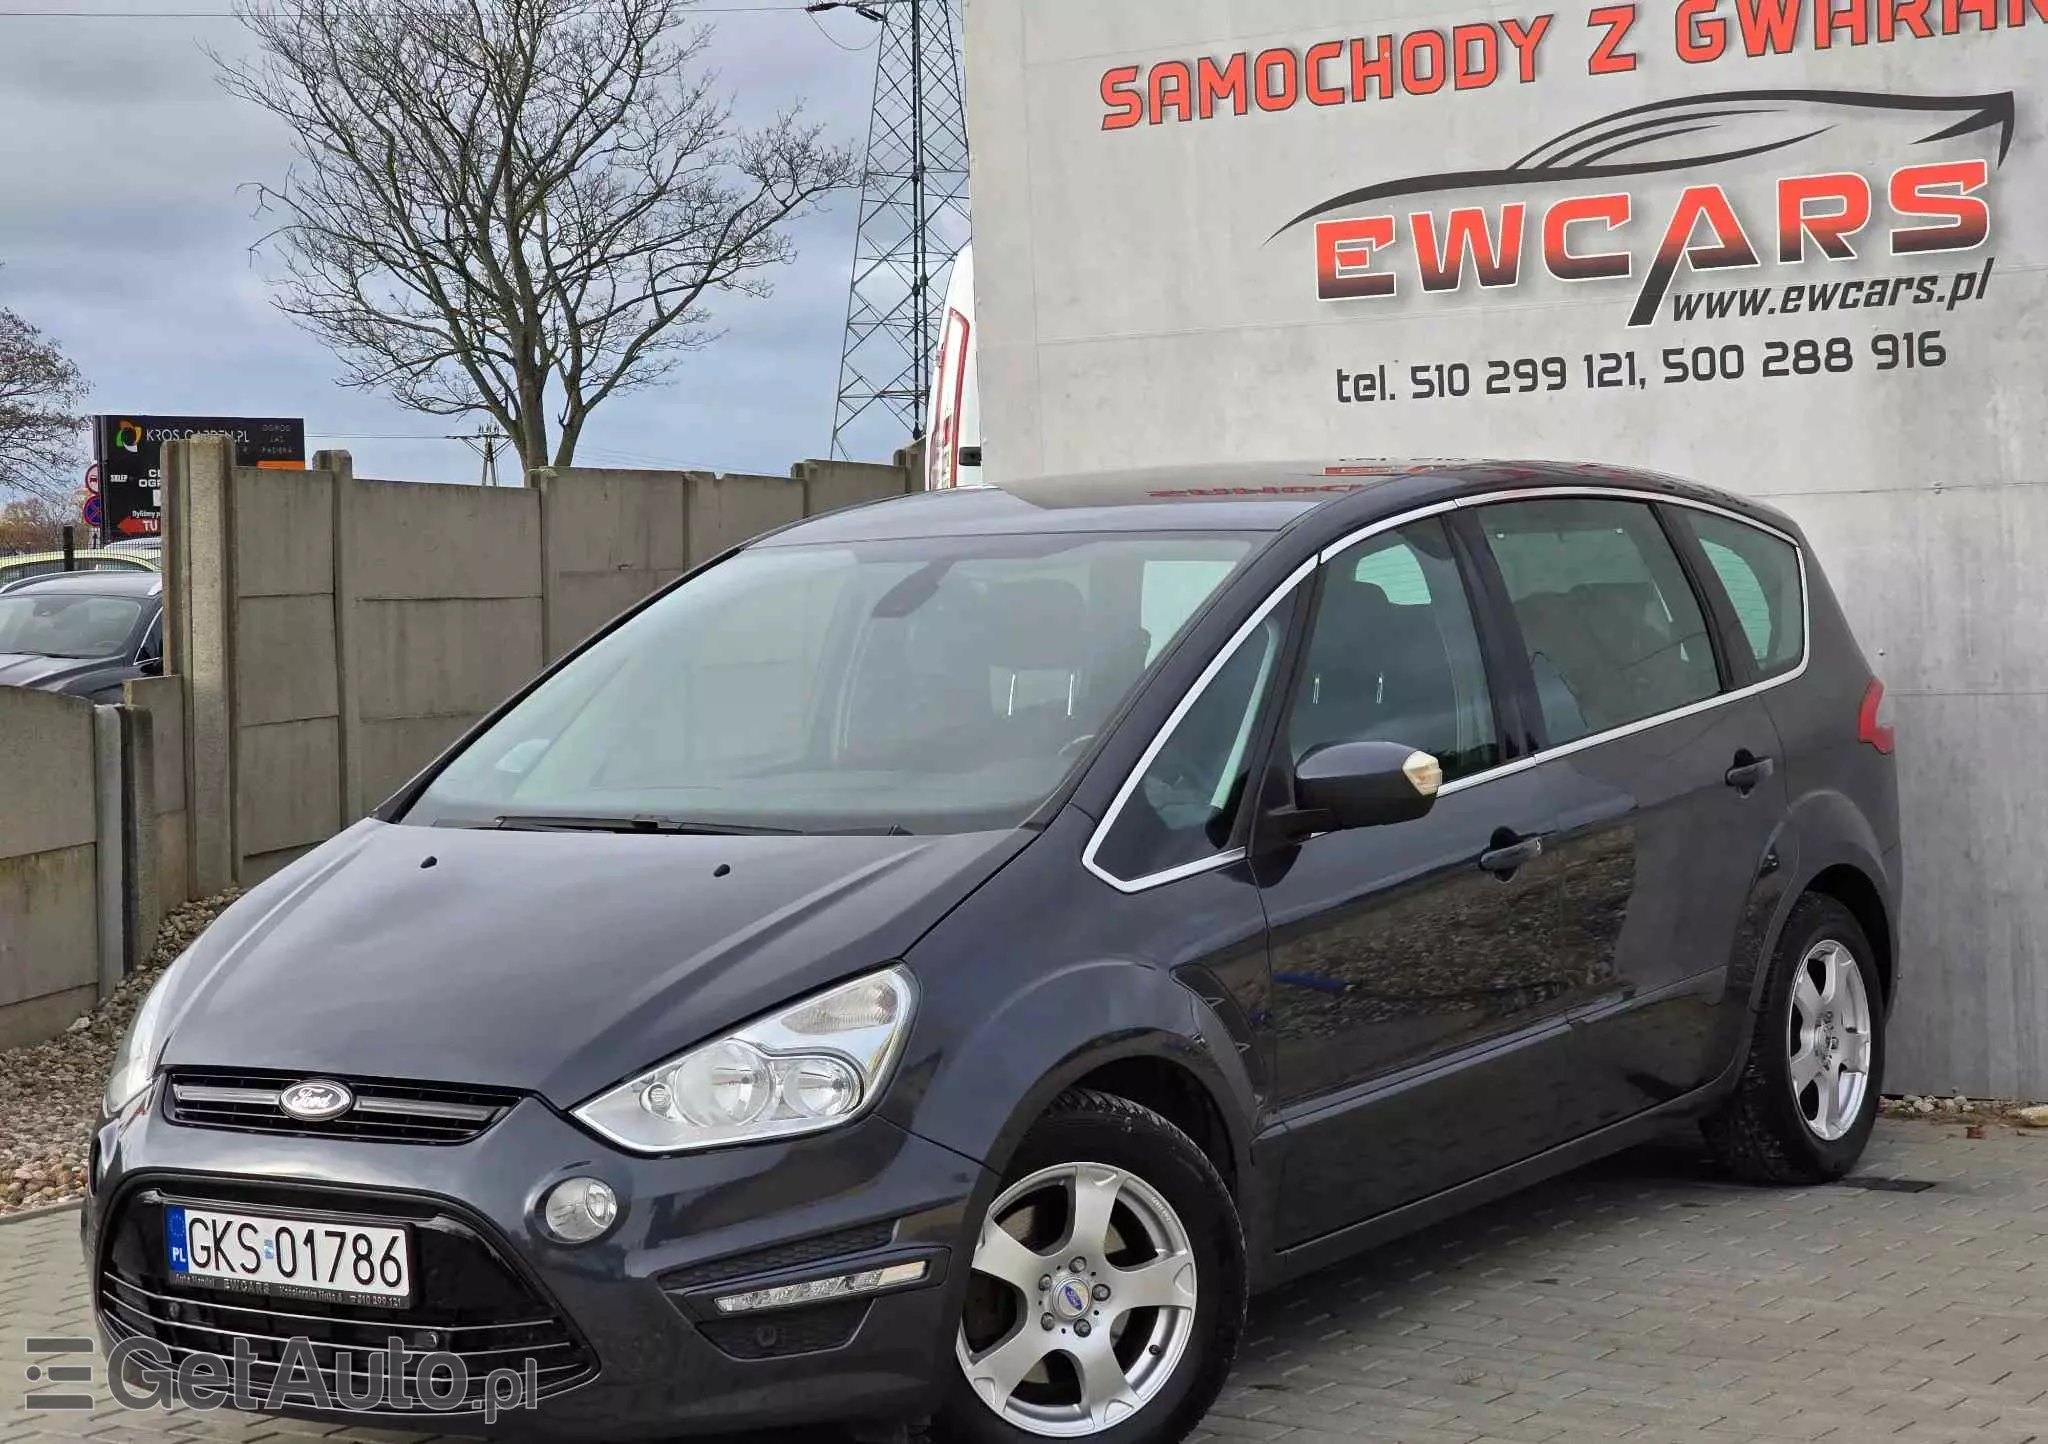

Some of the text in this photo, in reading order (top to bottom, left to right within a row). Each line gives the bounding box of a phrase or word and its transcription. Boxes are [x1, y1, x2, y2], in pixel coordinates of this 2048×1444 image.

[1100, 13, 1555, 131] SAMOCHODY
[1587, 3, 1638, 76] Z
[1312, 157, 1993, 329] EWCARS
[1672, 256, 1996, 322] www.ewcars.pl
[1336, 330, 1948, 403] tel. 510 299 121, 500 288 916
[143, 518, 158, 532] TU
[172, 1246, 186, 1263] PL
[188, 1217, 402, 1288] GKS 01786
